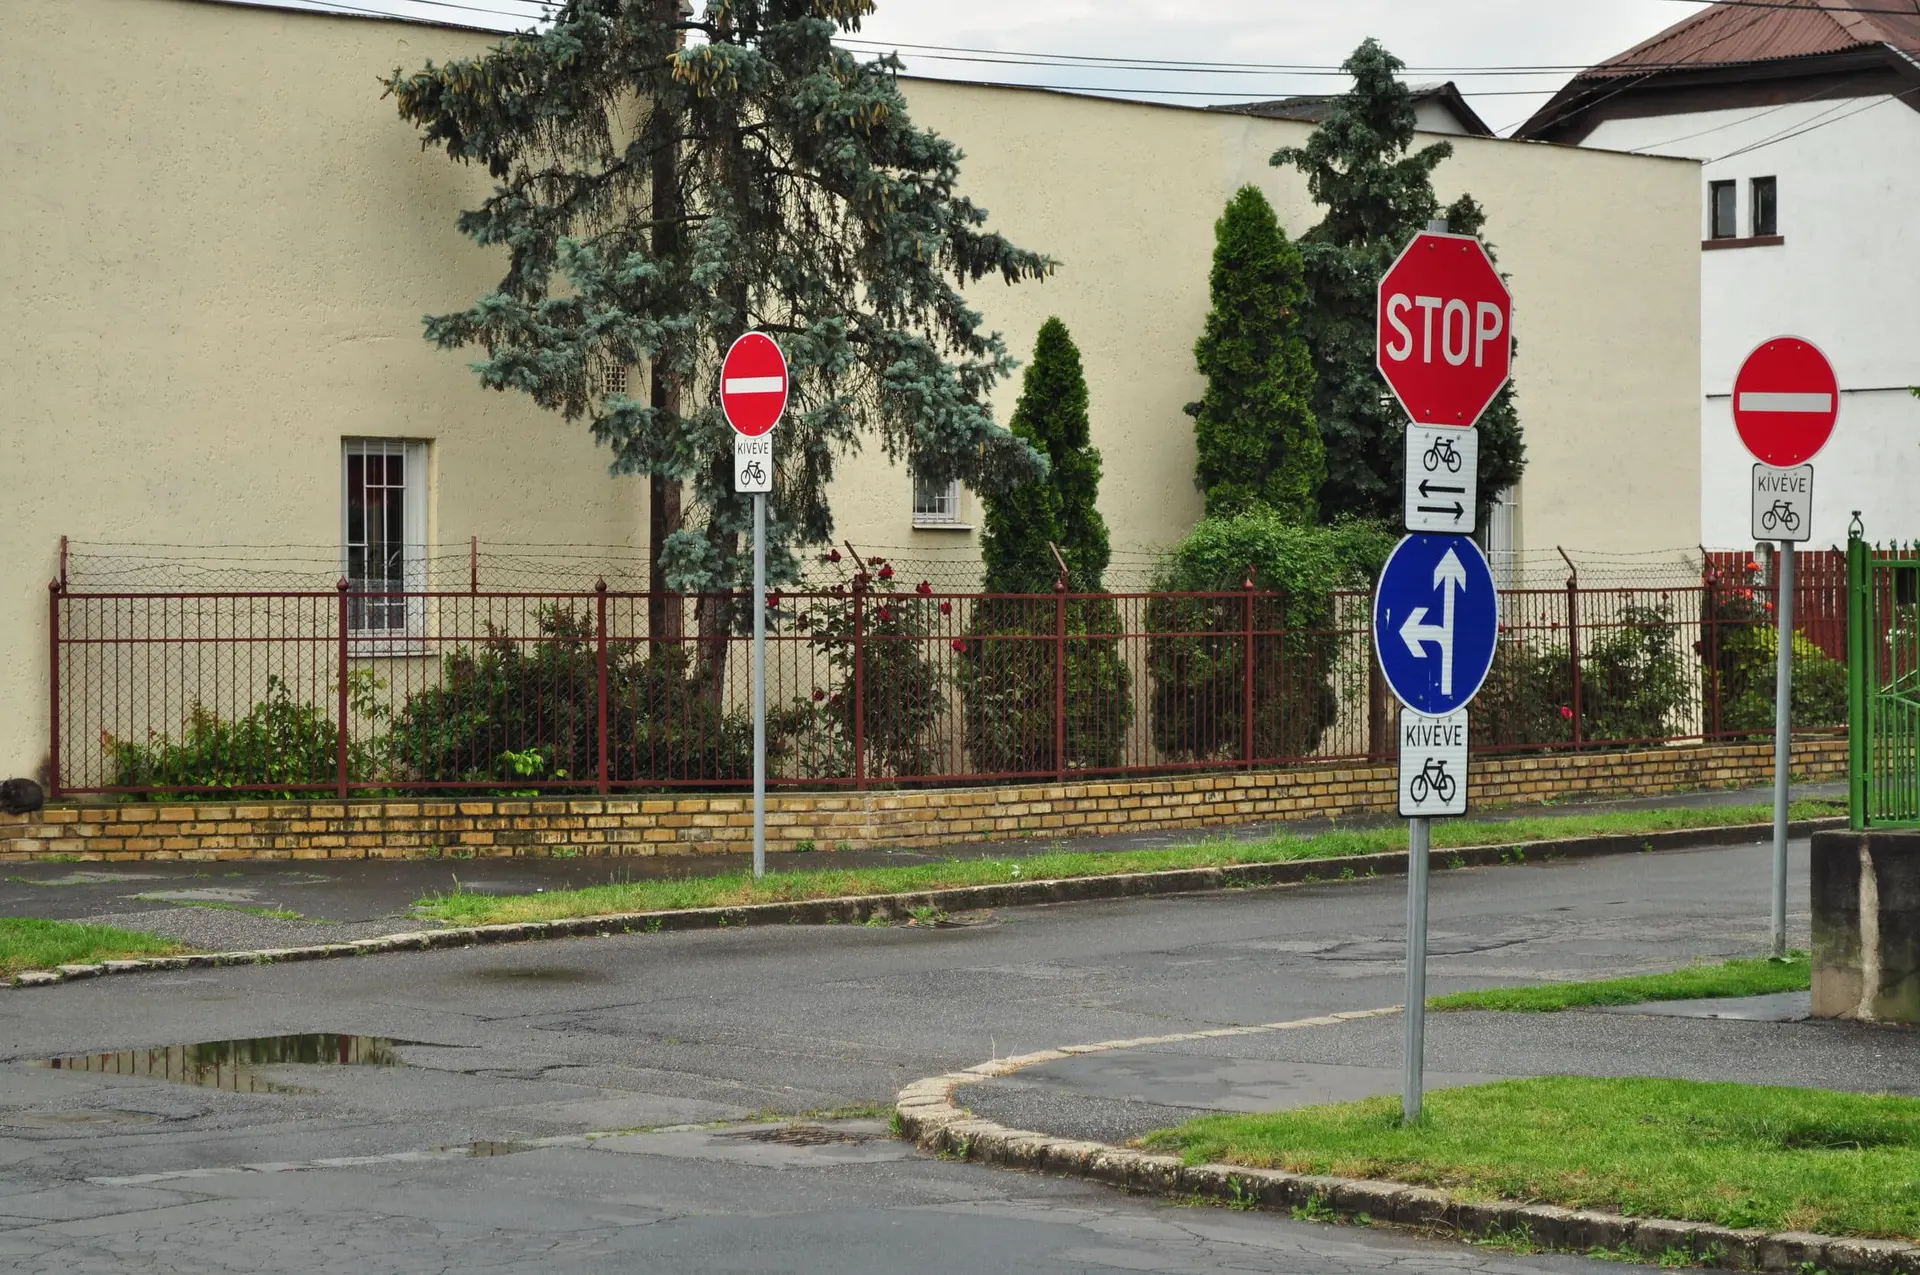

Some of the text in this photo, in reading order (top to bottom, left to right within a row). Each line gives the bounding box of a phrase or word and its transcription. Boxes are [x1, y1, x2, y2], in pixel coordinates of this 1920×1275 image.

[1386, 293, 1503, 367] STOP
[1758, 473, 1807, 493] KIVÉVE
[1406, 719, 1463, 747] KIVÉVE
